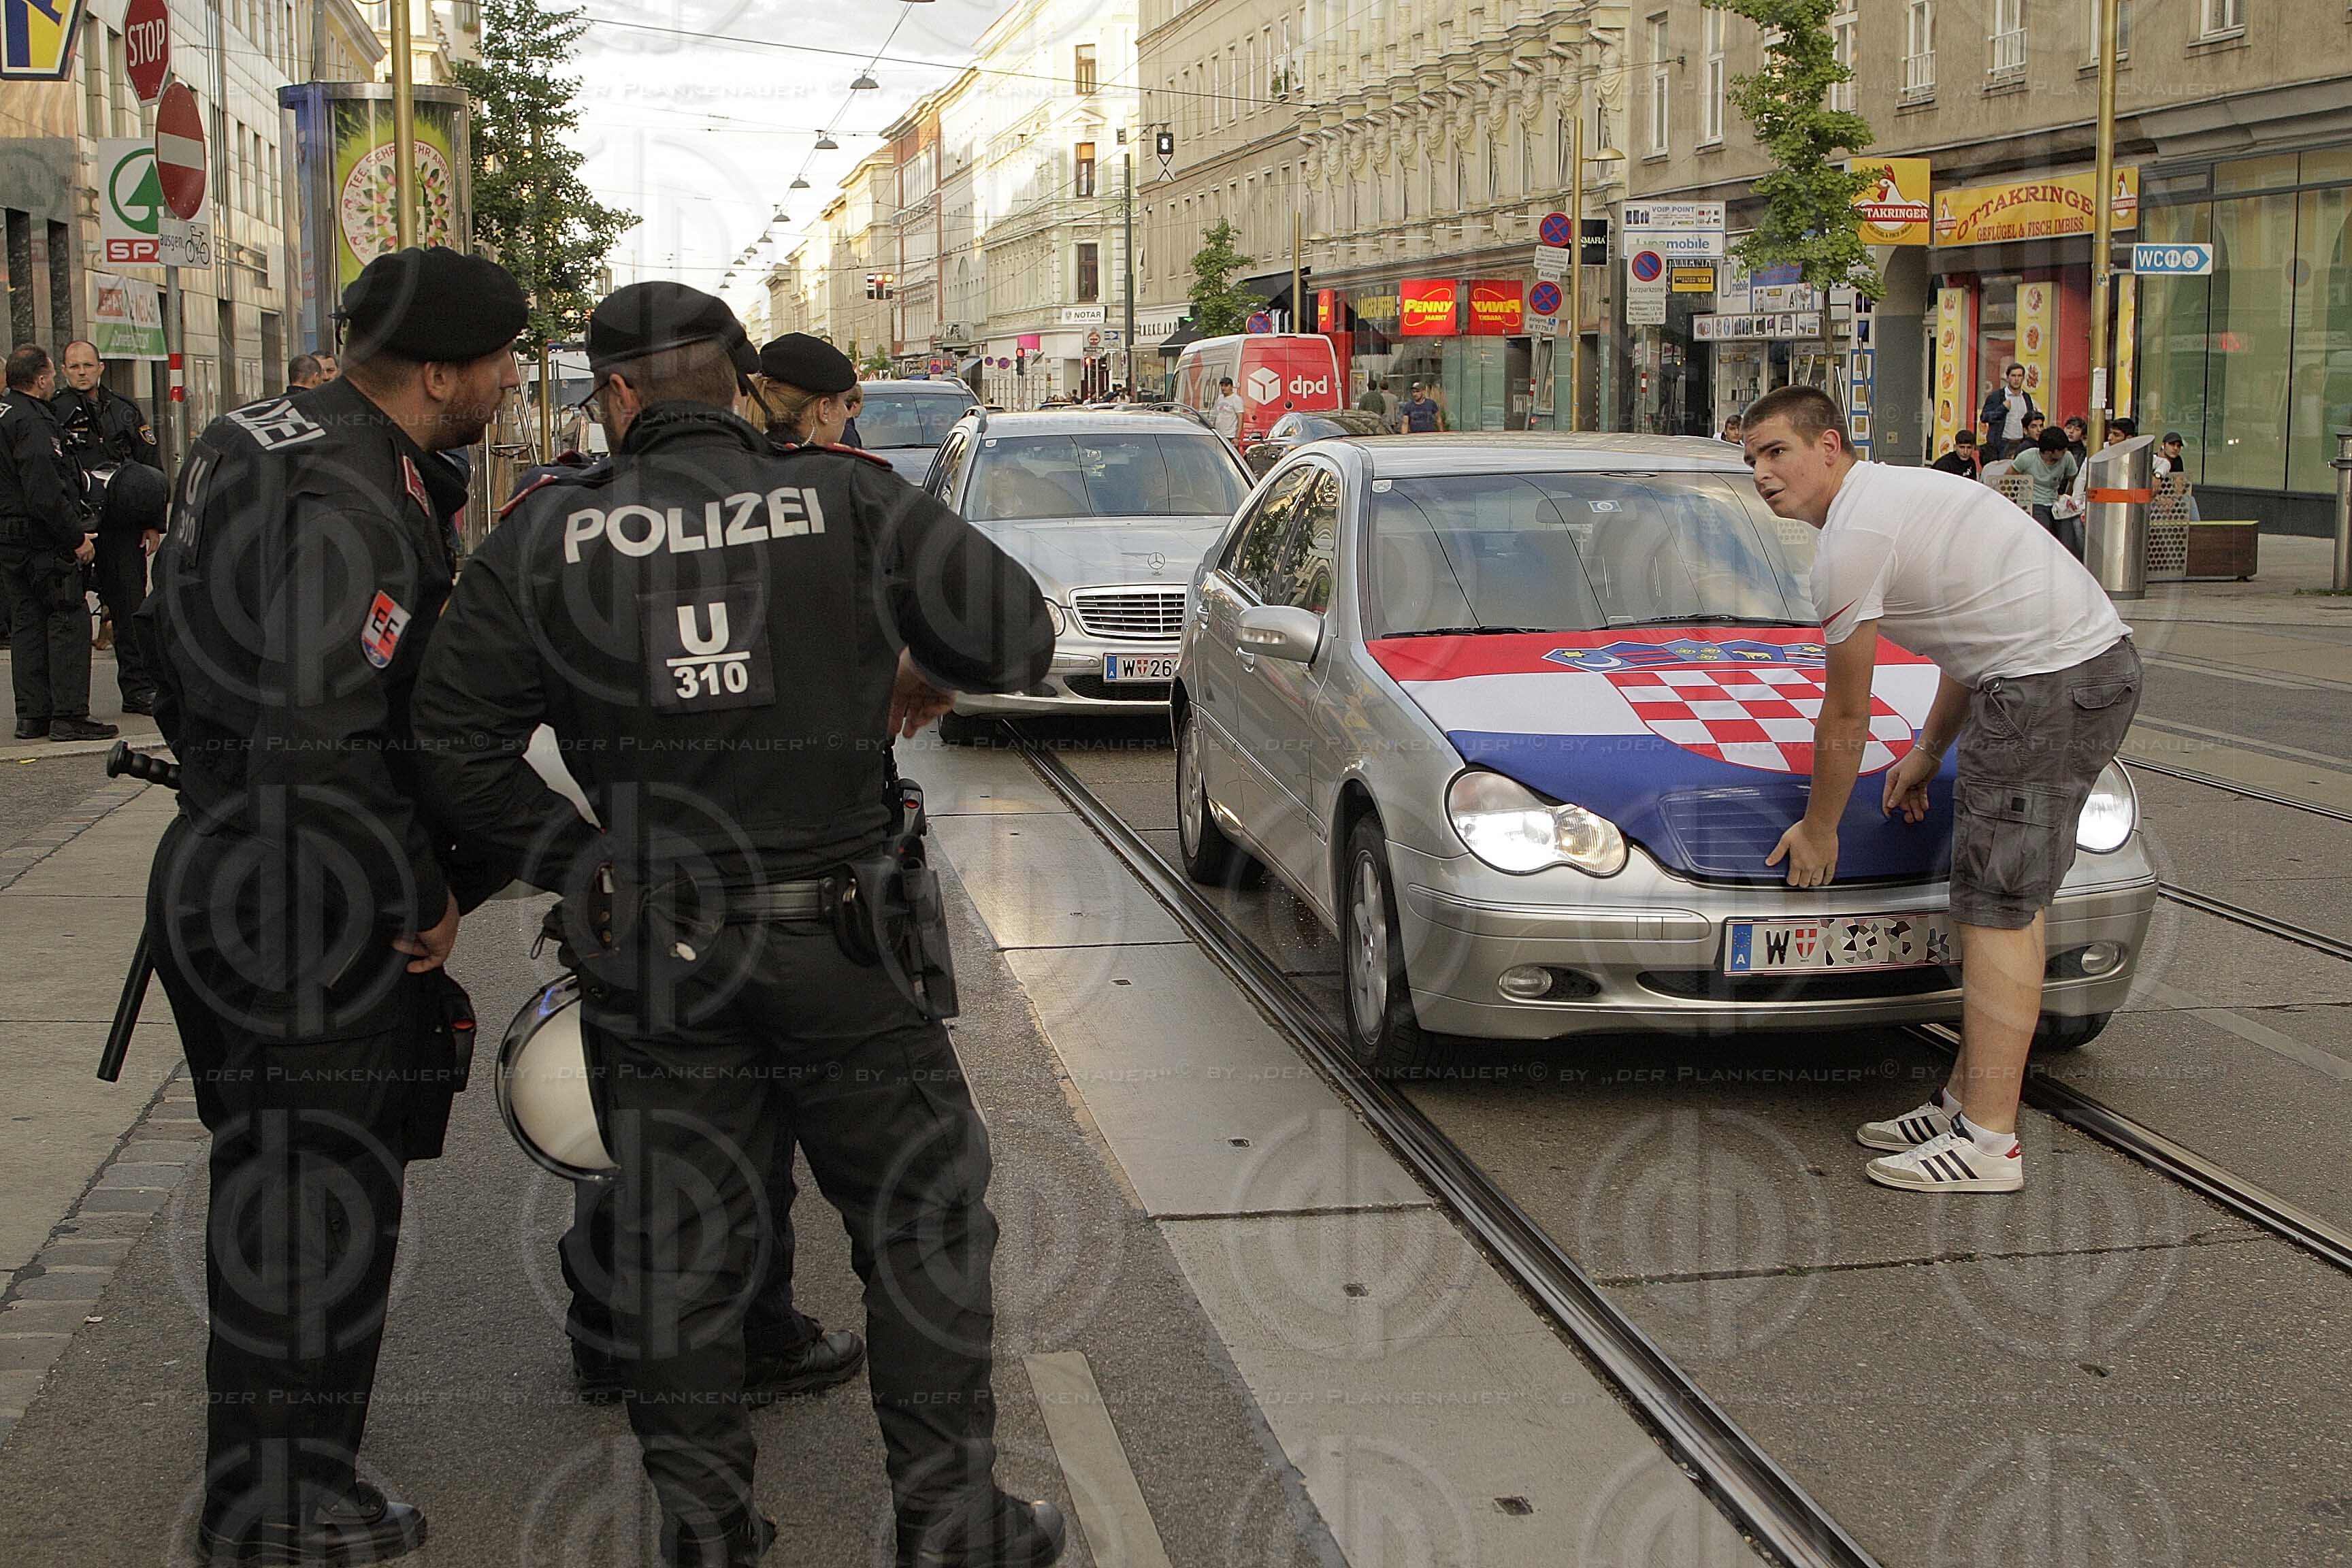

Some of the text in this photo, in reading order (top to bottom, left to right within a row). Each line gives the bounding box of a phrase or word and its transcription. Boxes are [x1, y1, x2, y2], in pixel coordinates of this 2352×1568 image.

[127, 18, 165, 67] STOP
[1860, 208, 1928, 218] TAKRINGER
[1957, 185, 2094, 240] OTTAKRINGE
[1976, 216, 2085, 241] GEFLÜGEL & FISCH IMBISS
[110, 242, 159, 259] SP
[160, 233, 184, 251] ausgen.
[2138, 250, 2164, 267] WC
[1403, 299, 1454, 313] PENNY
[1289, 375, 1328, 399] dpd
[186, 456, 208, 506] U
[564, 487, 826, 564] POLIZEI
[676, 602, 730, 655] U
[674, 661, 748, 699] 310
[1123, 659, 1136, 677] W
[1150, 659, 1179, 677] 26
[1735, 929, 1791, 965] A W
